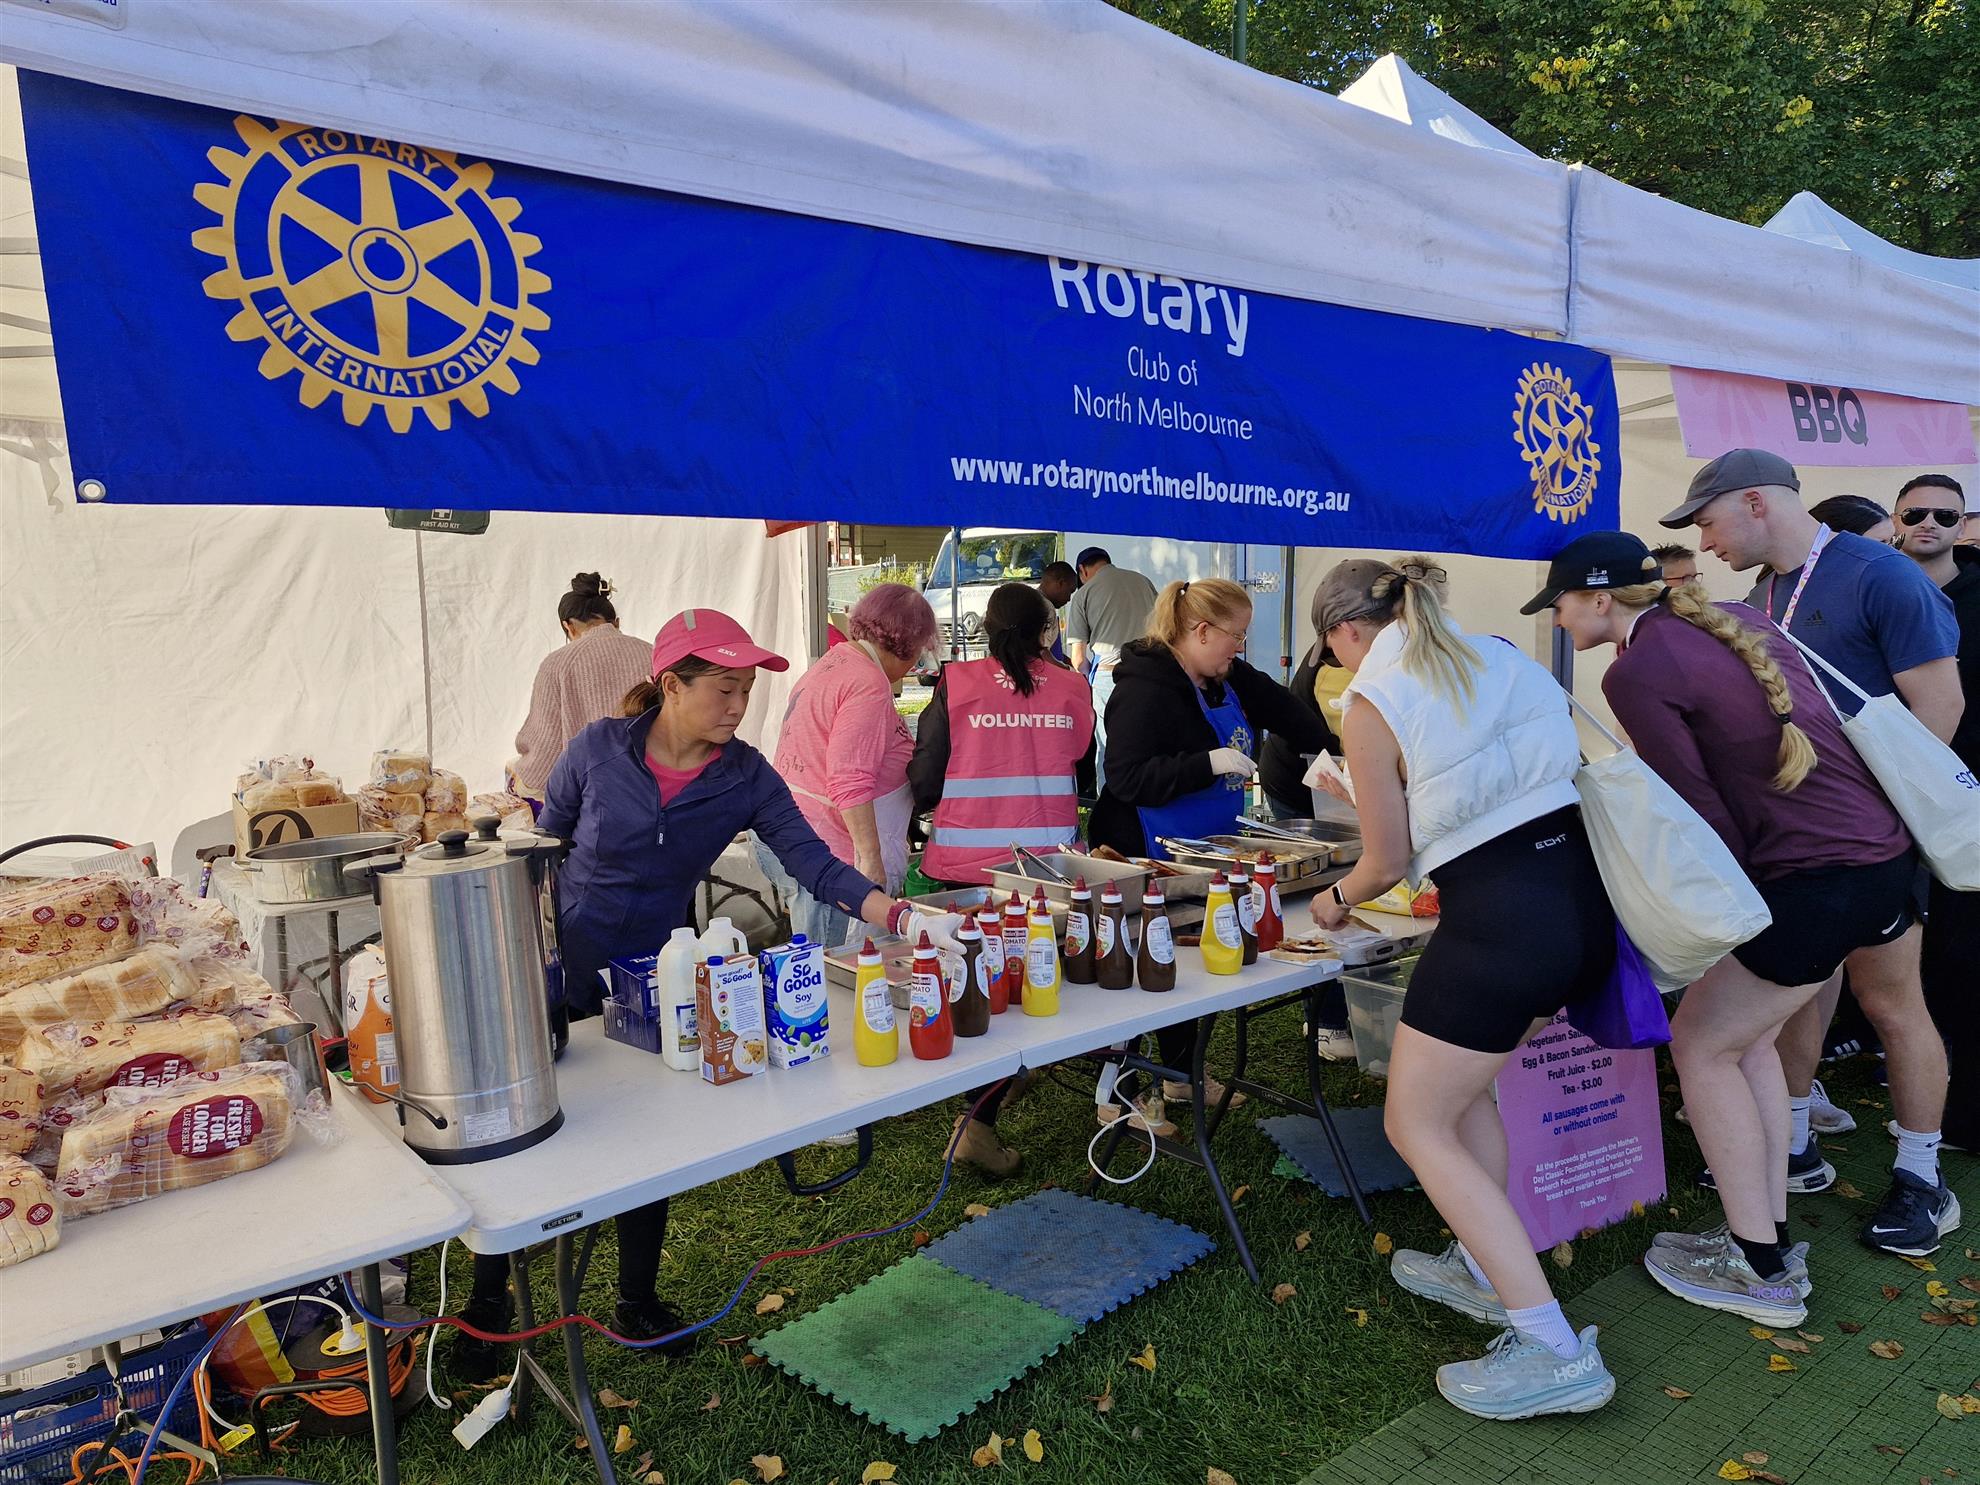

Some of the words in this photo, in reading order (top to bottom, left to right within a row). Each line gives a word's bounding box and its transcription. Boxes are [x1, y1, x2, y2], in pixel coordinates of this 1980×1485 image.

[1047, 255, 1249, 357] Rotary
[263, 303, 509, 395] INTERNATIONAL
[1127, 345, 1170, 382] Club
[1178, 359, 1199, 386] of
[1534, 379, 1567, 401] ROTARY
[1073, 383, 1132, 424] North
[1138, 396, 1253, 440] Melbourne
[1784, 381, 1869, 447] BBQ
[950, 456, 1350, 516] www.rotarynorthmelbourne.org.au
[420, 520, 437, 528] FIRST
[968, 713, 1074, 730] VOLUNTEER
[733, 971, 753, 983] Good
[783, 970, 822, 994] Good
[792, 963, 811, 979] So
[795, 992, 812, 1003] Soy
[1526, 1032, 1567, 1049] Vegetarian
[1521, 1057, 1538, 1070] Egg
[1539, 1053, 1545, 1064] &
[1546, 1051, 1570, 1063] Bacon
[1547, 1067, 1566, 1081] Fruit
[1567, 1063, 1586, 1077] Juice
[1591, 1056, 1613, 1071] $2.00
[1561, 1085, 1576, 1096] Tea
[1581, 1076, 1603, 1091] $3.00
[1542, 1111, 1553, 1124] All
[1554, 1104, 1589, 1121] sausages
[1589, 1099, 1609, 1111] come
[1609, 1092, 1626, 1105] with
[1553, 1126, 1562, 1136] or
[1563, 1117, 1592, 1133] without
[1592, 1108, 1618, 1125] onions!
[191, 1103, 210, 1154] LONGER
[209, 1115, 226, 1143] FOR
[224, 1099, 244, 1150] FRESHER
[1532, 1175, 1545, 1185] Day
[1545, 1169, 1565, 1180] Classic
[1565, 1159, 1594, 1175] Foundation
[1595, 1156, 1605, 1165] and
[1605, 1150, 1625, 1161] Ovarian
[1625, 1145, 1643, 1156] Cancer
[1535, 1163, 1544, 1173] All
[1545, 1162, 1554, 1170] the
[1554, 1155, 1580, 1168] proceeds
[1579, 1153, 1587, 1162] go
[1587, 1146, 1608, 1158] towards
[1608, 1143, 1617, 1151] the
[1617, 1136, 1639, 1148] Mother's
[1534, 1181, 1560, 1195] Research
[1560, 1171, 1590, 1186] Foundation
[1590, 1169, 1597, 1177] to
[1597, 1165, 1610, 1175] raise
[1610, 1161, 1624, 1172] funds
[1624, 1158, 1632, 1167] for
[1632, 1154, 1643, 1164] vital
[1546, 1190, 1564, 1201] breast
[1564, 1186, 1575, 1196] and
[1575, 1181, 1595, 1192] ovarian
[1595, 1175, 1612, 1186] cancer
[1579, 1198, 1596, 1209] Thank
[1596, 1194, 1607, 1202] You
[1747, 1285, 1795, 1301] HOKA
[1553, 1354, 1599, 1384] HOKA
